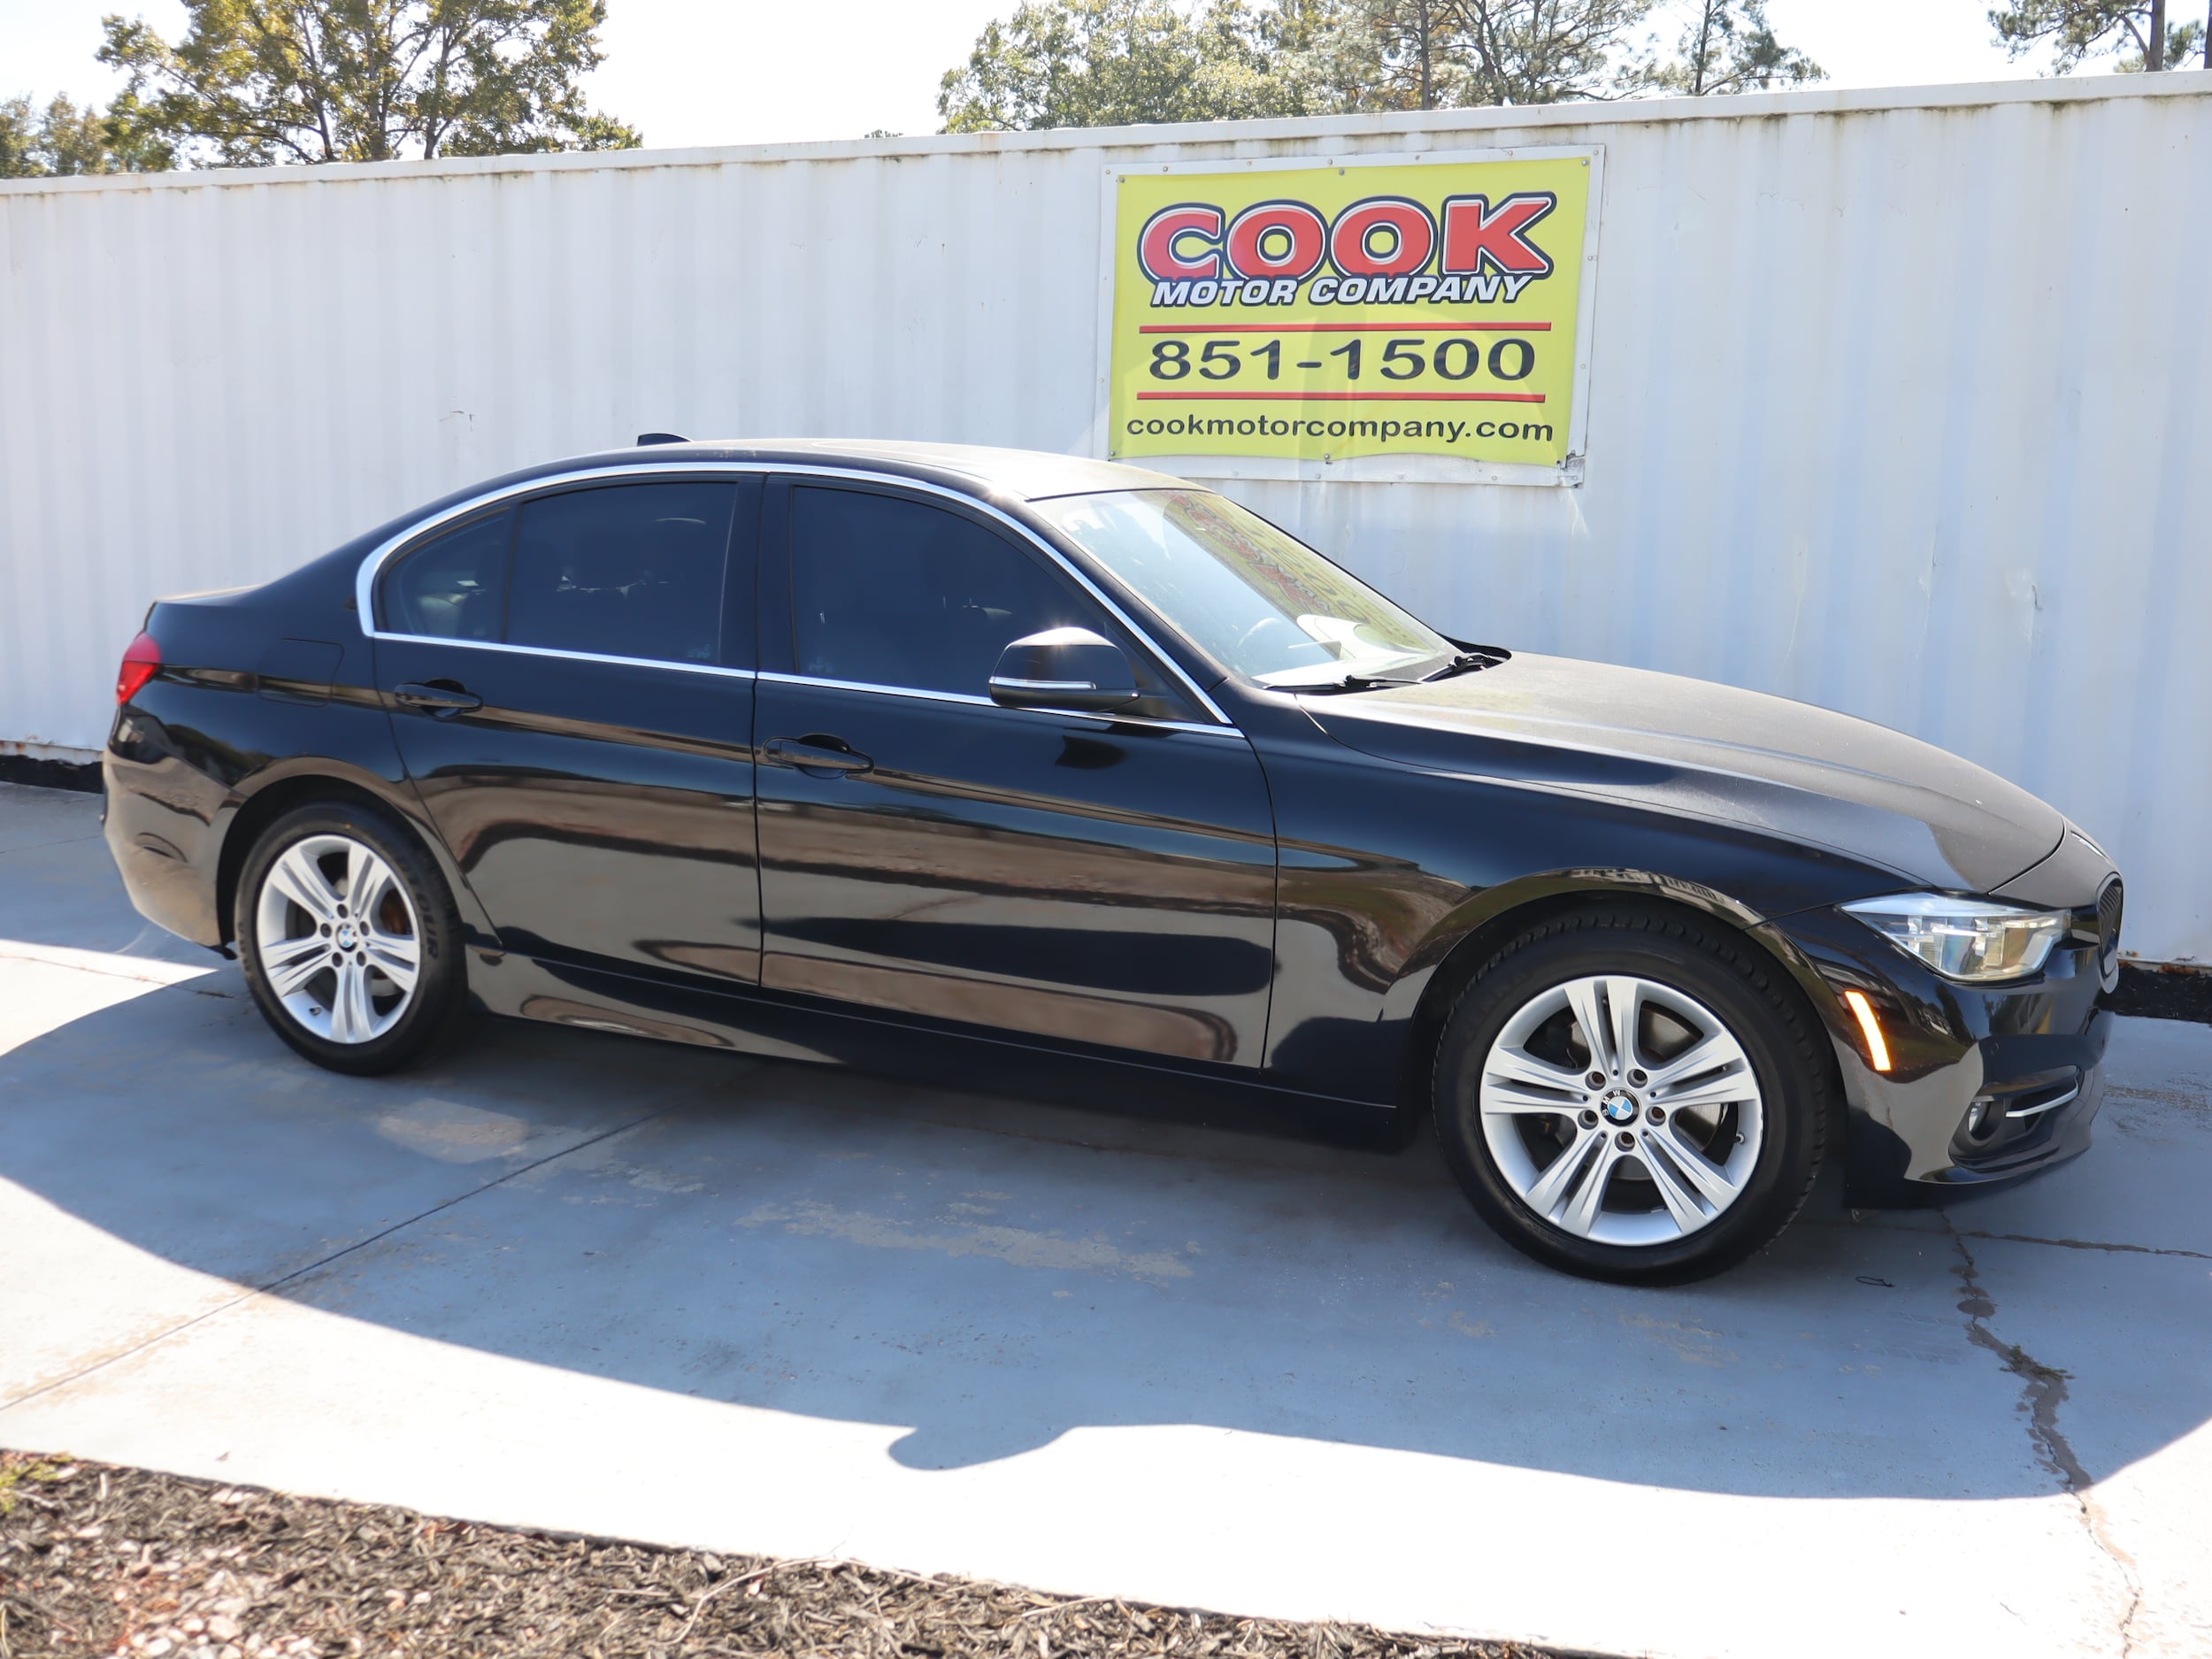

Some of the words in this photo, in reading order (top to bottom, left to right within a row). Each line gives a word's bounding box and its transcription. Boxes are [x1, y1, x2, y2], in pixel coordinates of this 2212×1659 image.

[1138, 192, 1556, 281] COOK
[1151, 277, 1297, 307] MOTOR
[1309, 275, 1532, 305] COMPANY
[1149, 338, 1535, 381] 851-1500
[1126, 414, 1553, 443] cookmotorcompany.com
